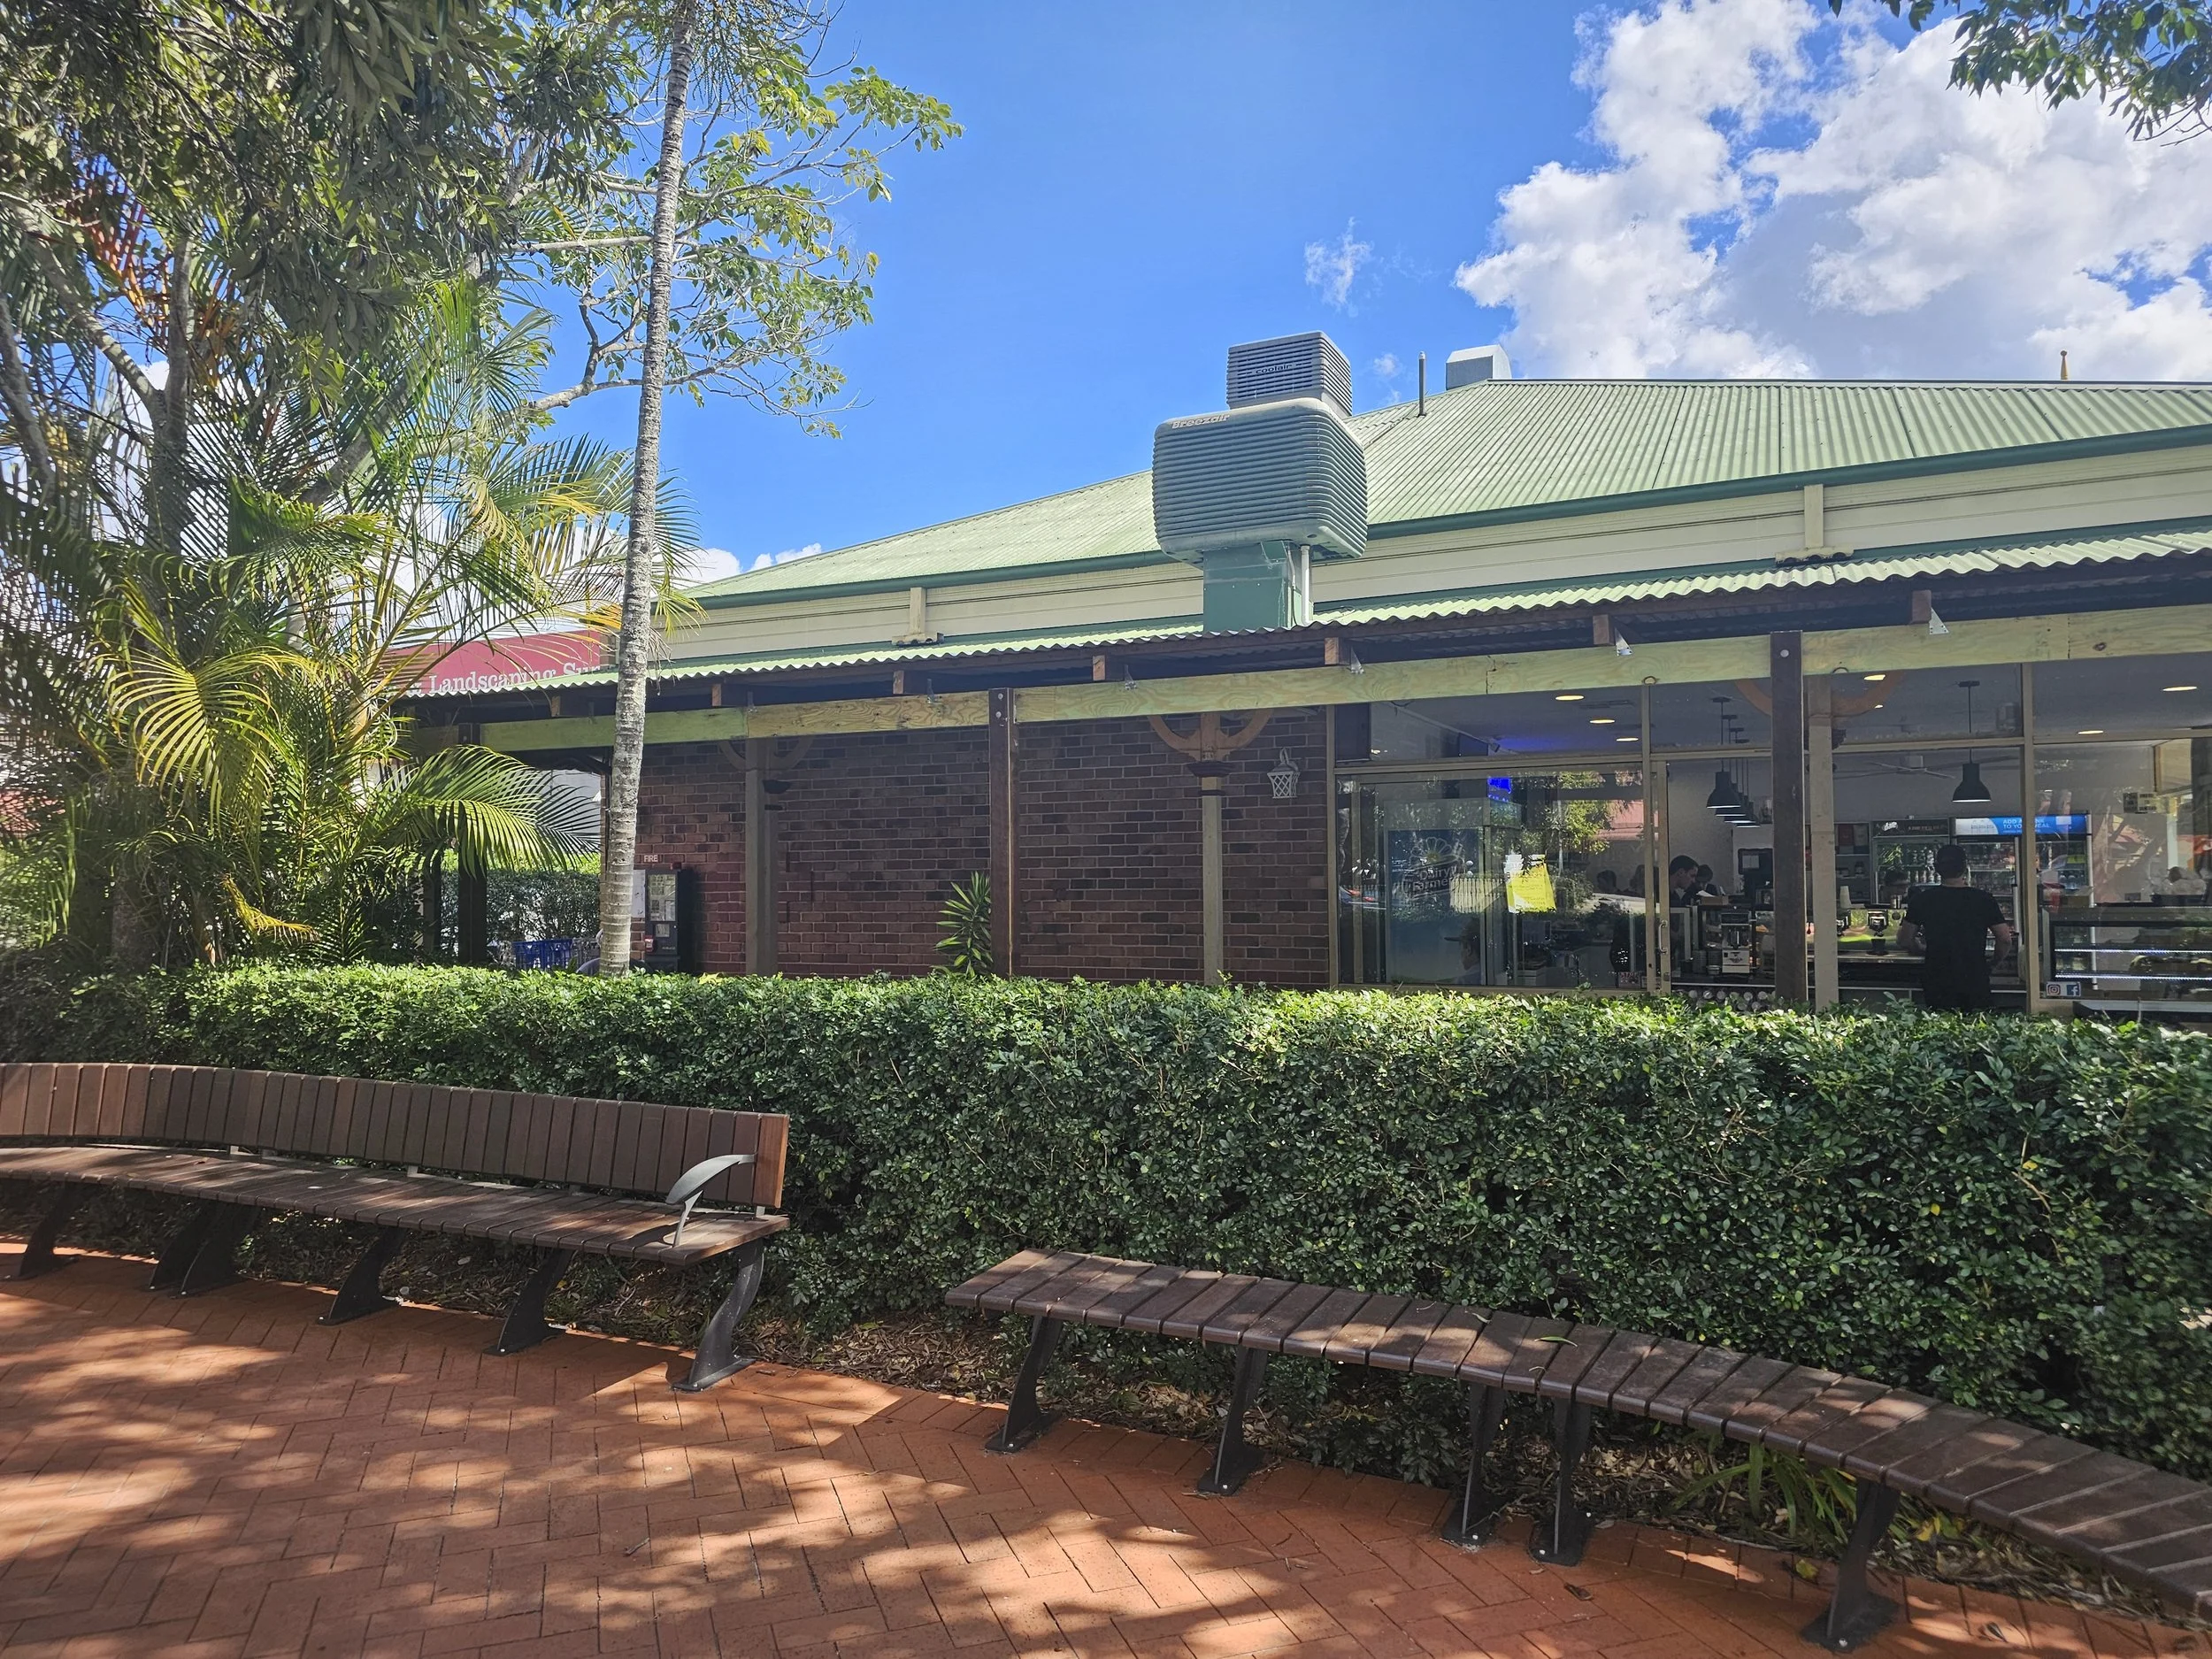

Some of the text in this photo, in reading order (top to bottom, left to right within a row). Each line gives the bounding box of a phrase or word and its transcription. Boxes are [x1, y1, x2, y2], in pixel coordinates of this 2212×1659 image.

[1256, 363, 1293, 374] coolair
[1171, 414, 1230, 429] Breezair
[1419, 867, 1450, 880] Dairy
[1413, 878, 1448, 892] Farme
